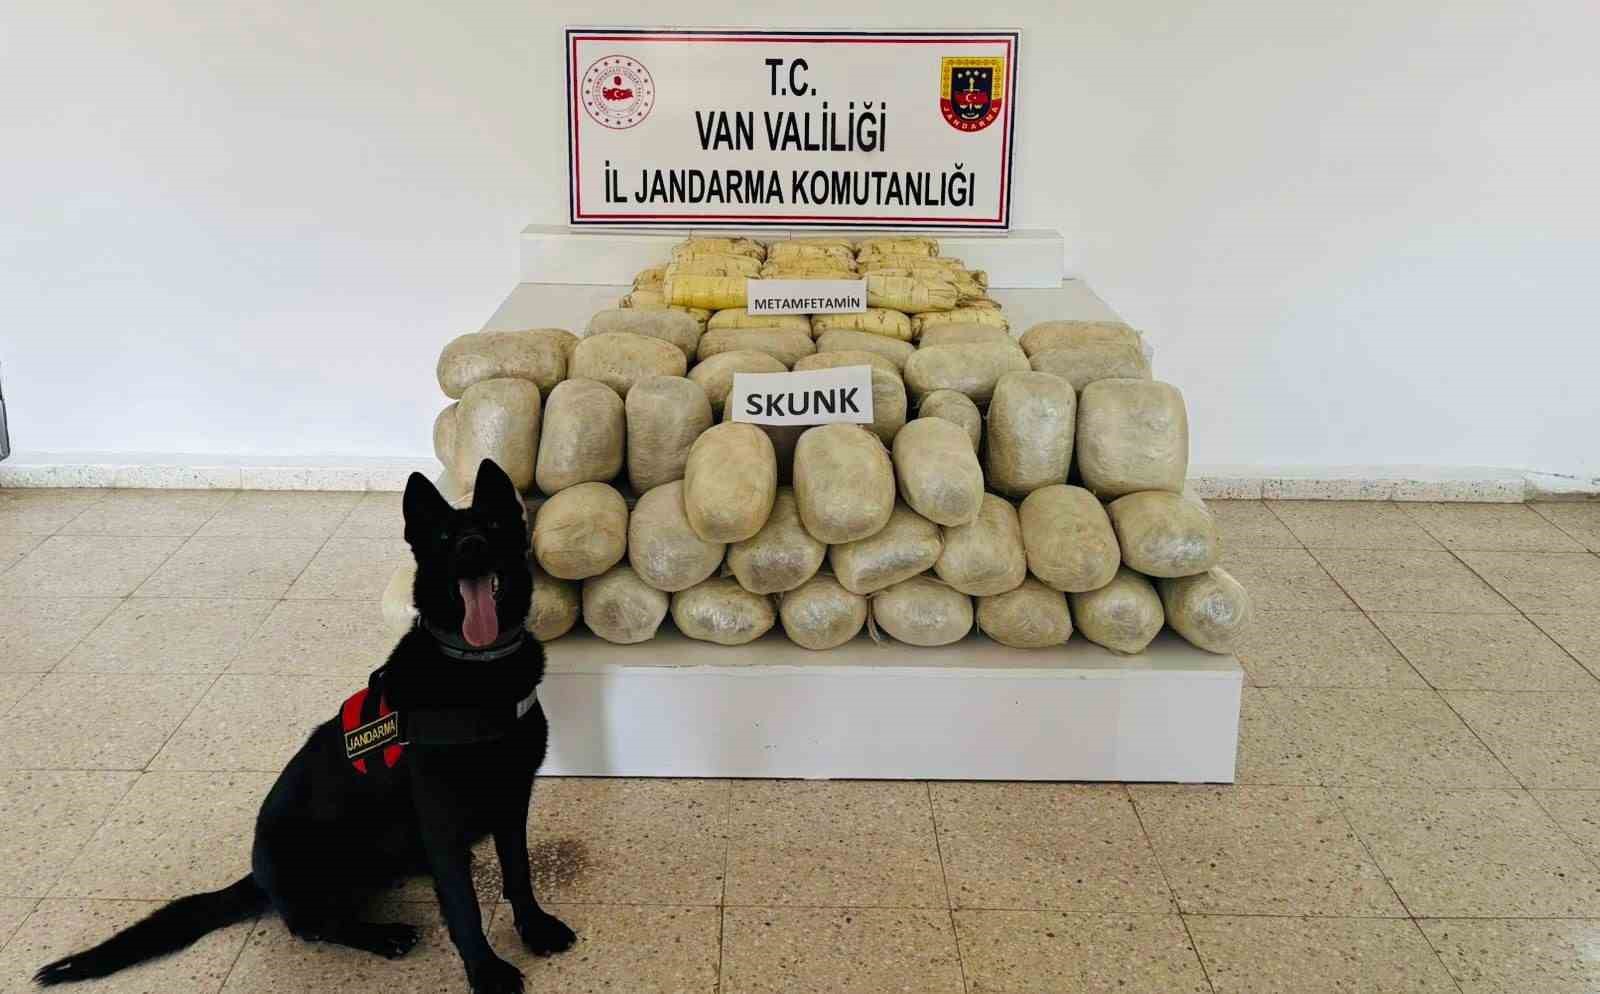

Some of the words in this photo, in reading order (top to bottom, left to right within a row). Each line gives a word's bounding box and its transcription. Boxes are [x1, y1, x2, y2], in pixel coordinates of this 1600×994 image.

[764, 58, 817, 97] T.C.
[695, 110, 754, 151] VAN
[763, 101, 886, 153] VALİLİĞİ
[943, 104, 999, 130] JANDARMA
[605, 159, 628, 204] İL
[634, 169, 785, 205] JANDARMA
[791, 162, 976, 207] KOMUTANLIĞI
[754, 295, 861, 311] METAMFETAMİN
[745, 387, 860, 417] SKUNK
[348, 719, 396, 750] JANDARMA
